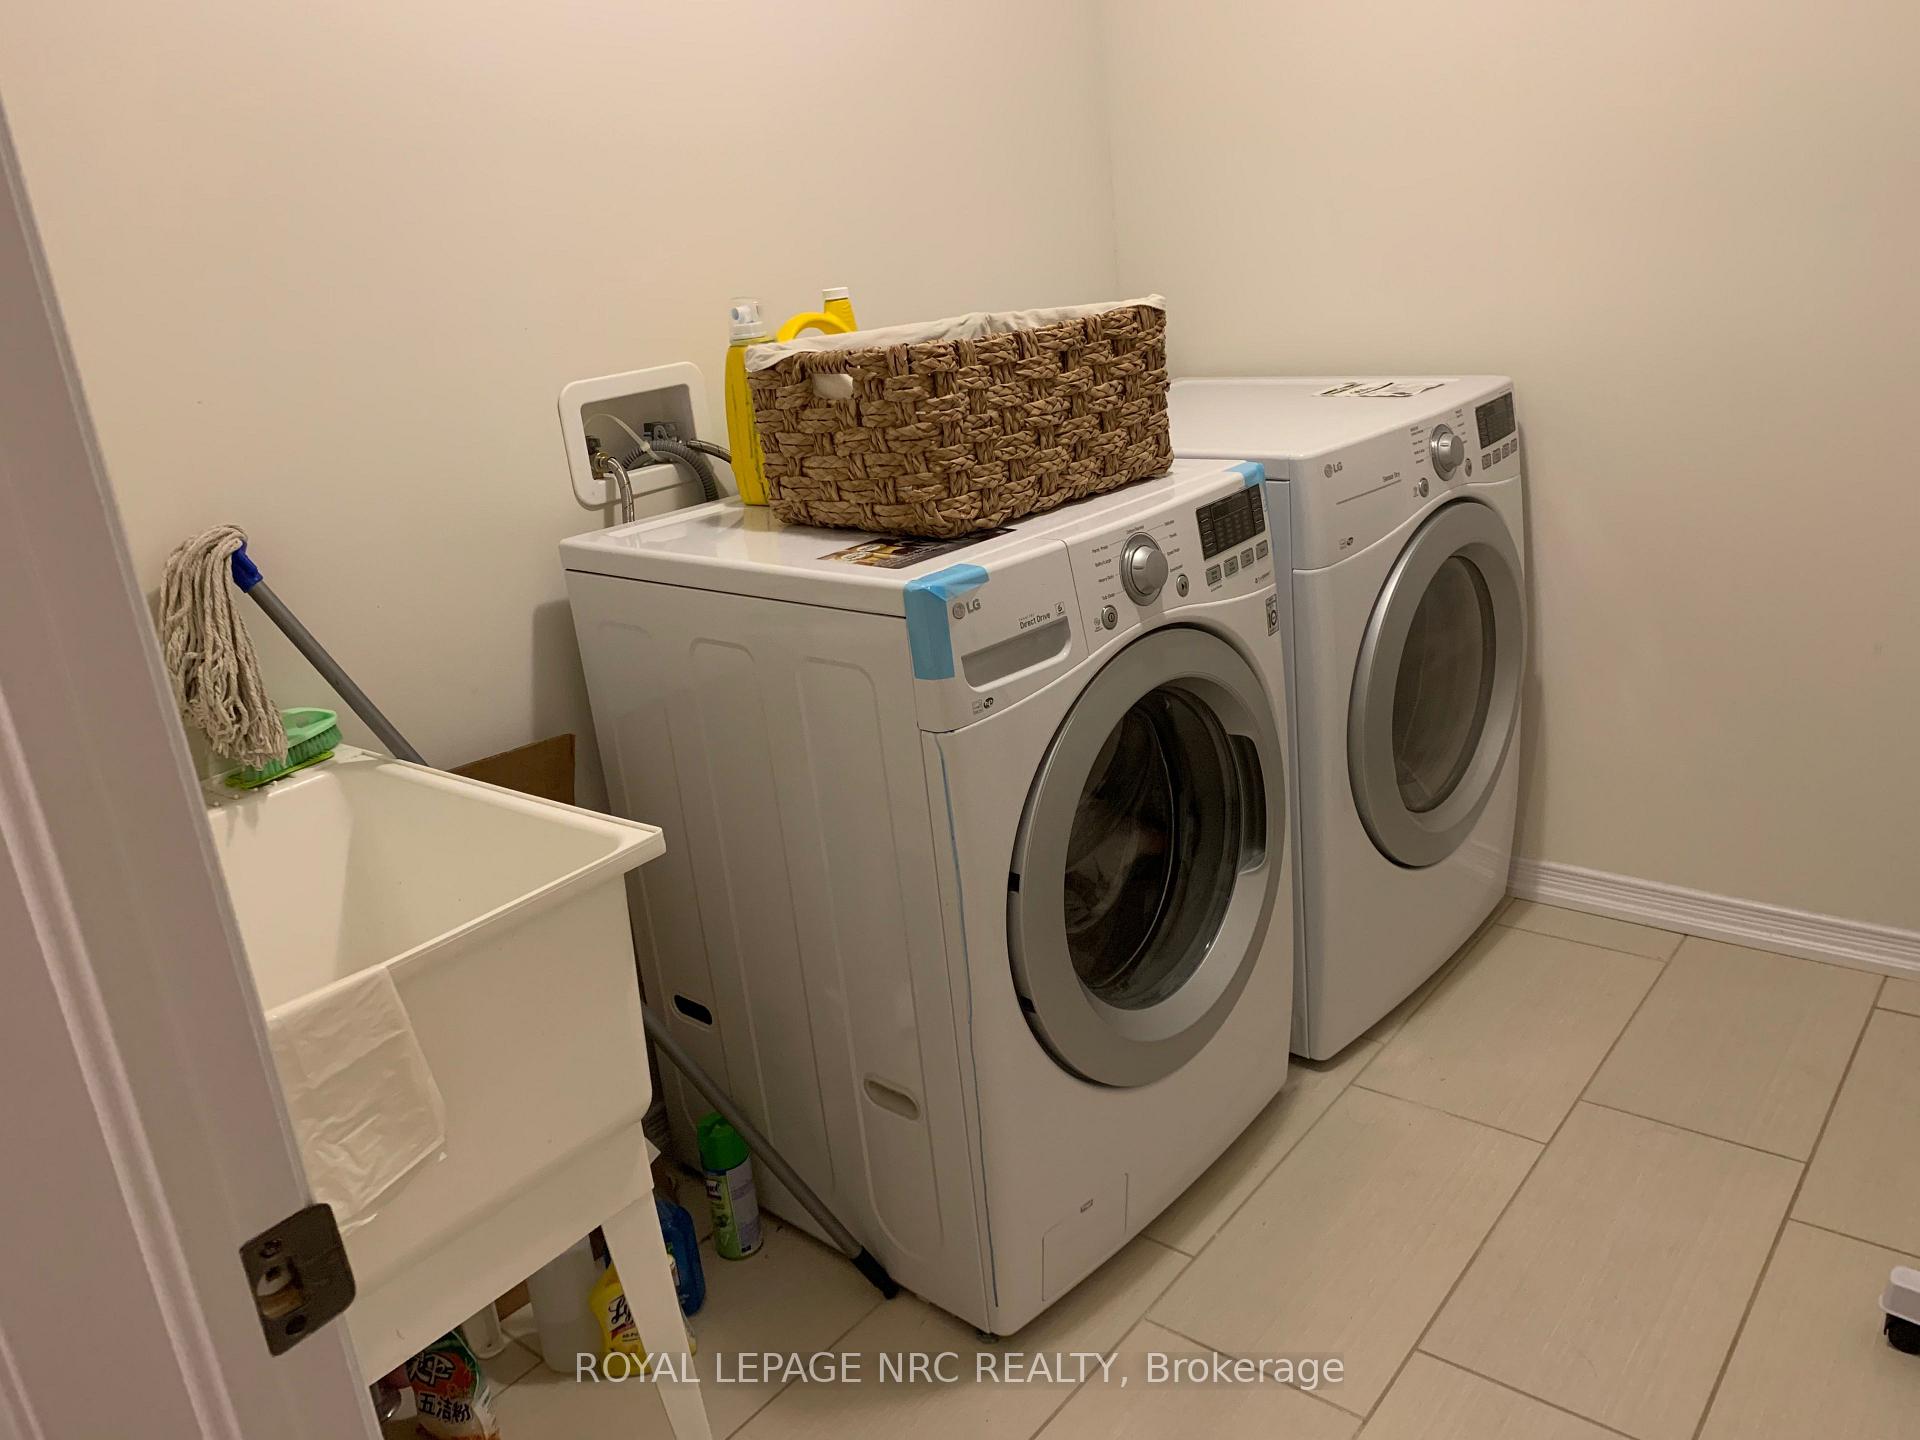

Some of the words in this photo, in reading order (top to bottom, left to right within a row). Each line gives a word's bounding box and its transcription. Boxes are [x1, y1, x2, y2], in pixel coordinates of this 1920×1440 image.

[1019, 617, 1037, 630] Direct
[1036, 612, 1051, 624] Drive
[419, 1391, 471, 1424] 五洁粉
